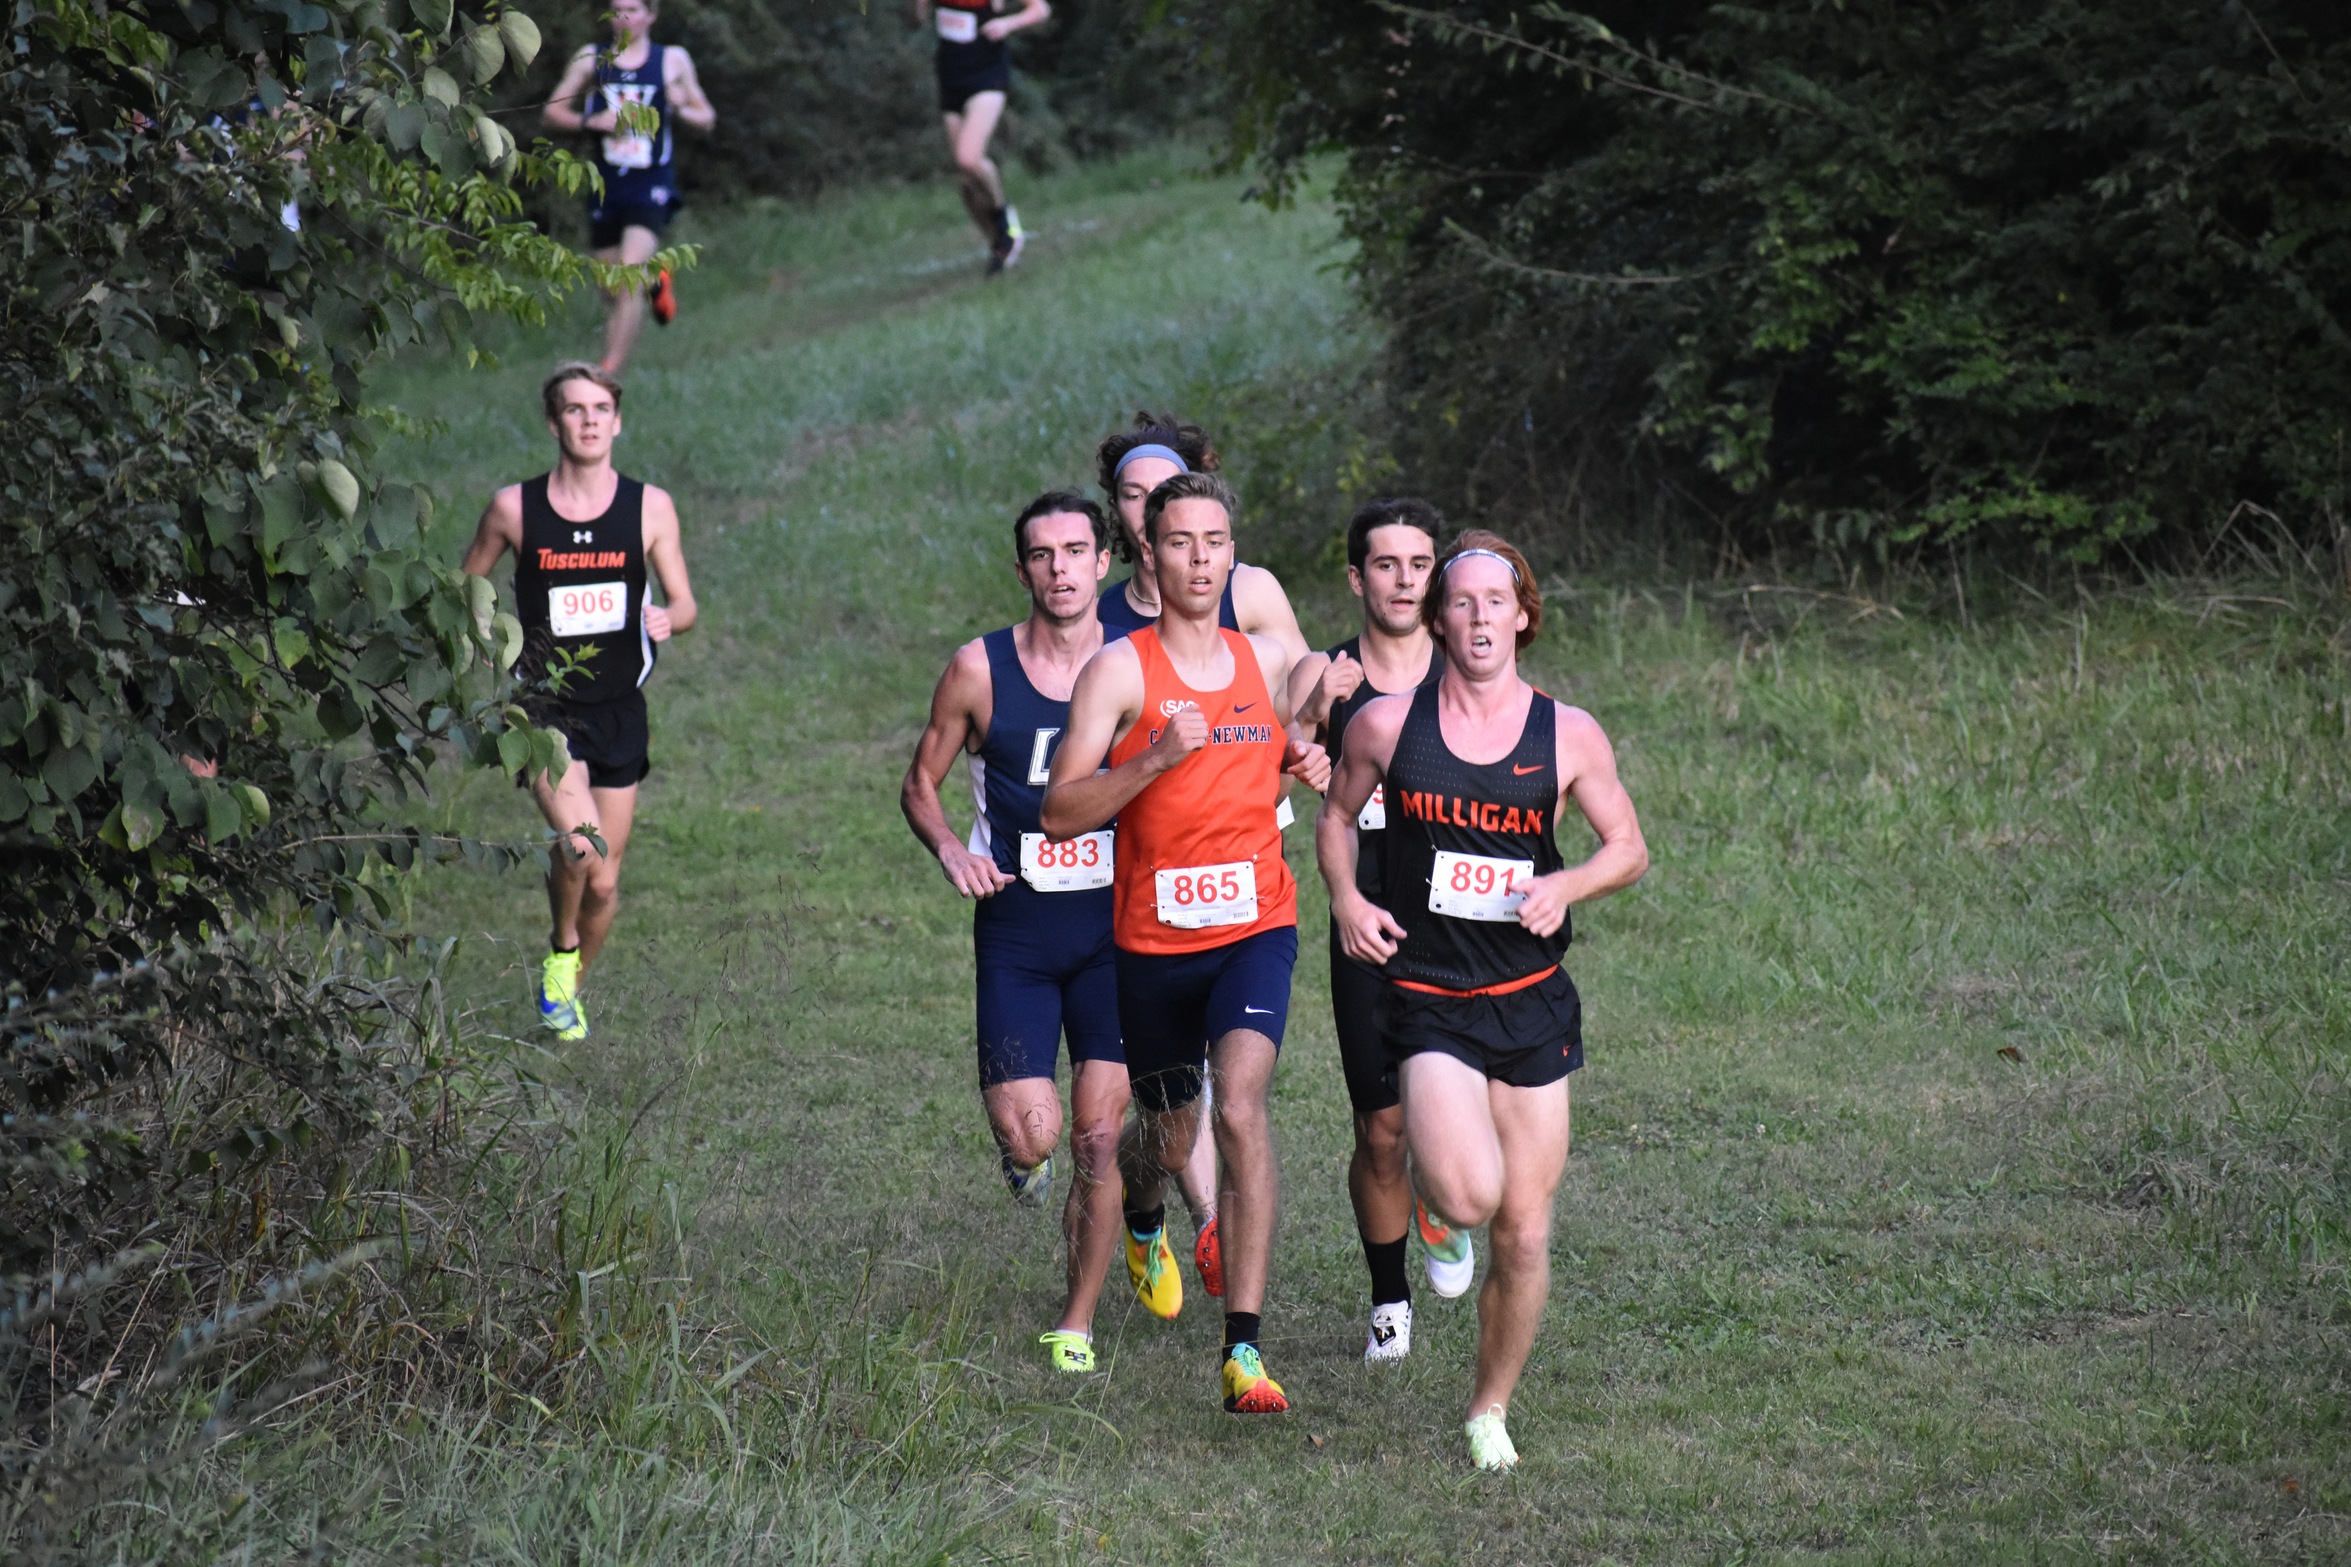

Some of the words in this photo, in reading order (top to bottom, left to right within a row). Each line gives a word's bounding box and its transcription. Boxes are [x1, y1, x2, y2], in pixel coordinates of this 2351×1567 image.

[537, 548, 626, 570] TUSCULUM
[563, 590, 614, 615] 906
[1149, 725, 1271, 746] C-NEWMAN
[1400, 790, 1543, 835] MILLIGAN
[1037, 838, 1099, 868] 883
[1174, 871, 1240, 906] 865
[1450, 861, 1515, 897] 891
